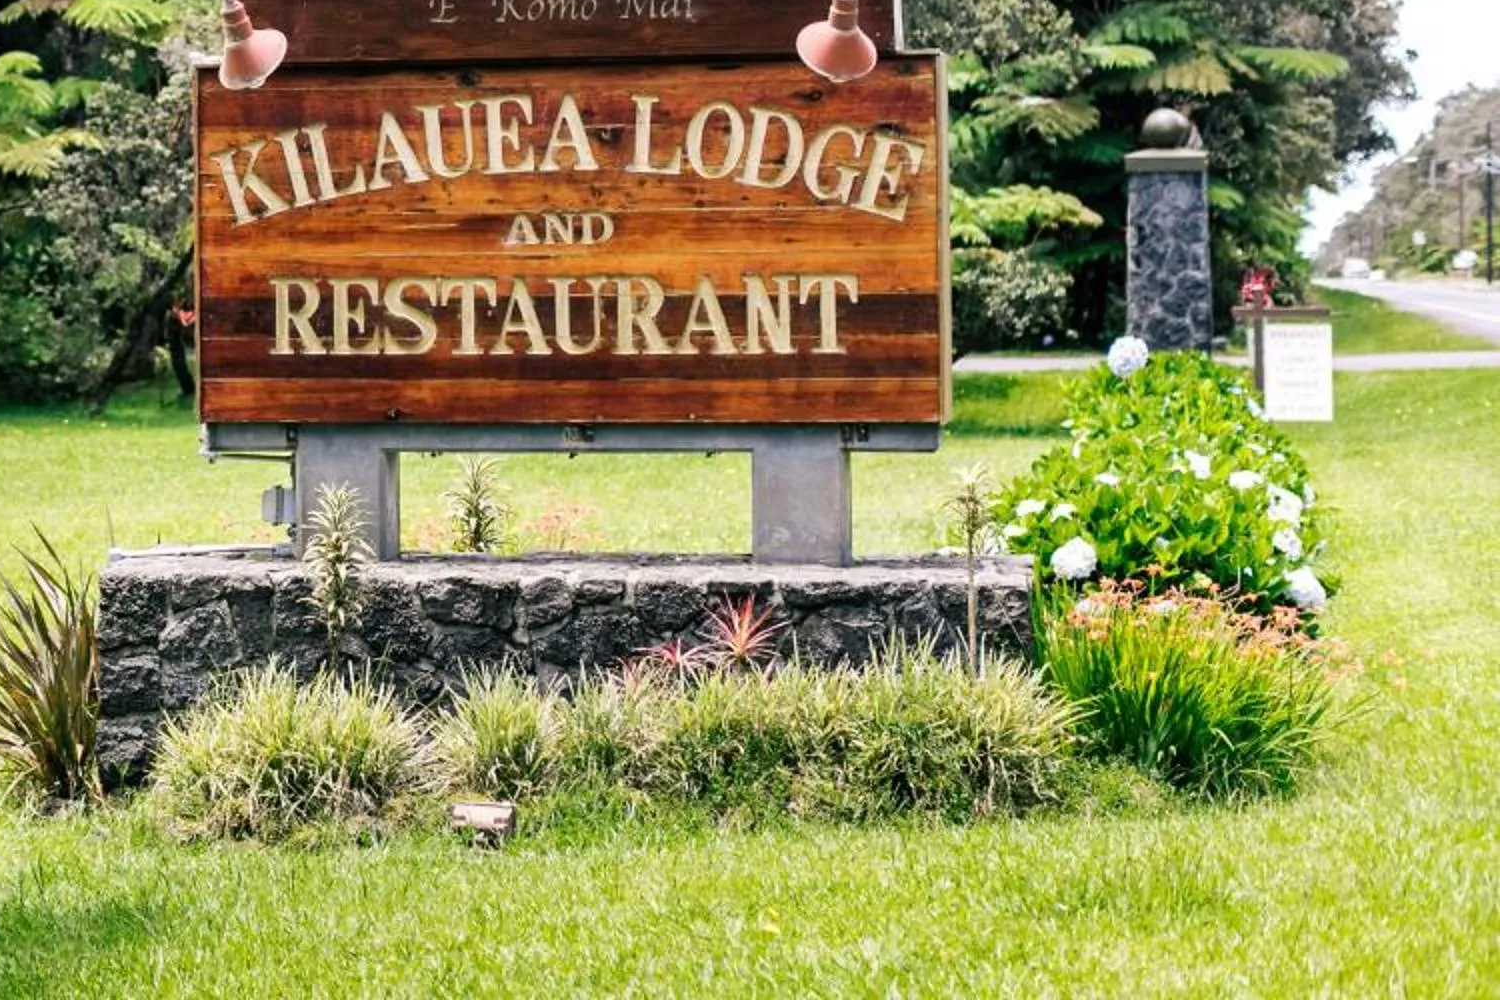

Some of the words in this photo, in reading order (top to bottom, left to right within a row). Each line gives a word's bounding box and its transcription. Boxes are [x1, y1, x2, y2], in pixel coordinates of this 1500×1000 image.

[210, 94, 599, 227] KILAUEA
[626, 95, 926, 221] LODGE
[505, 213, 614, 245] AND
[269, 274, 859, 356] RESTAURANT
